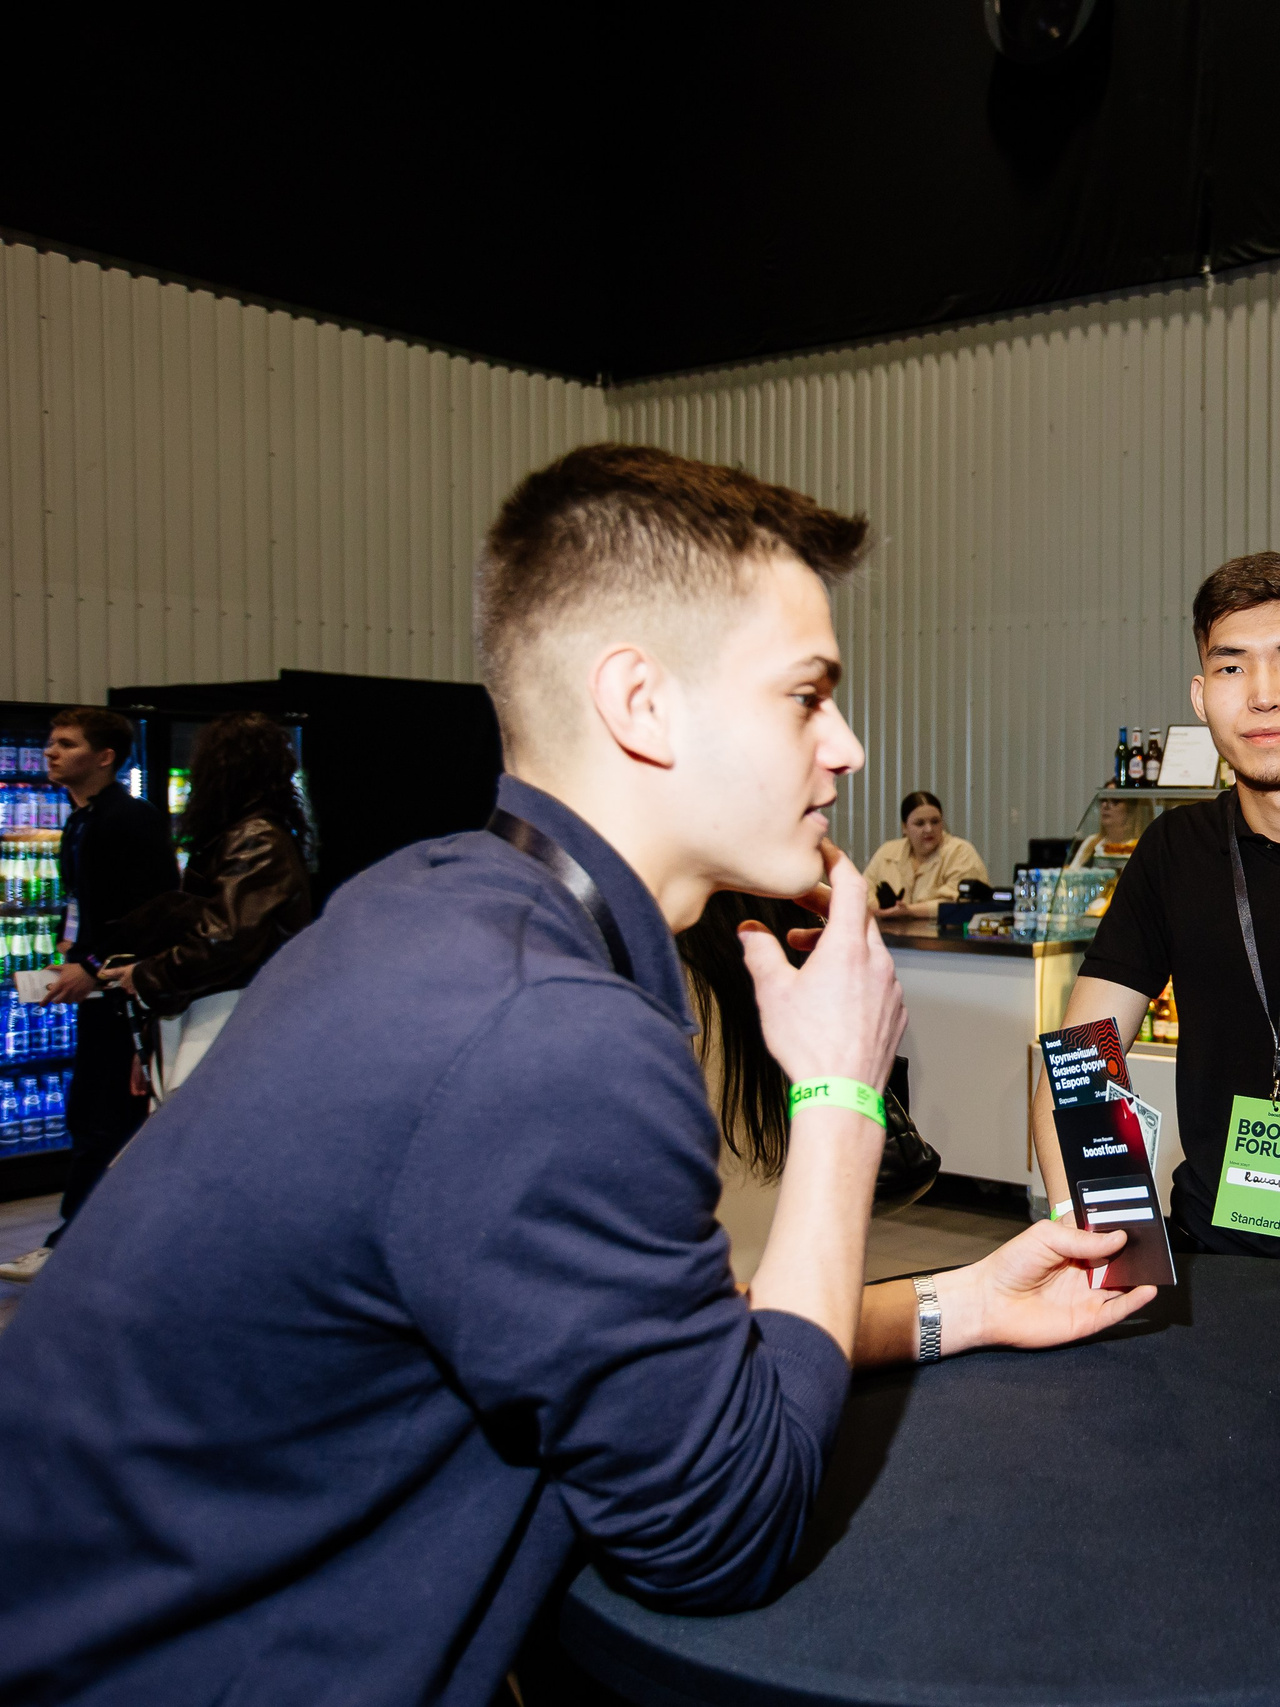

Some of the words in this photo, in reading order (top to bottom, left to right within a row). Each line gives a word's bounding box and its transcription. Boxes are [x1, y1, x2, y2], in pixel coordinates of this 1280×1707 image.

[1049, 1044, 1098, 1066] Крупнейший
[1052, 1063, 1081, 1078] бизнес
[1081, 1059, 1107, 1074] форум
[1055, 1081, 1061, 1091] в
[1060, 1075, 1090, 1090] Европе
[1082, 1145, 1106, 1158] boost
[1105, 1143, 1128, 1155] forum
